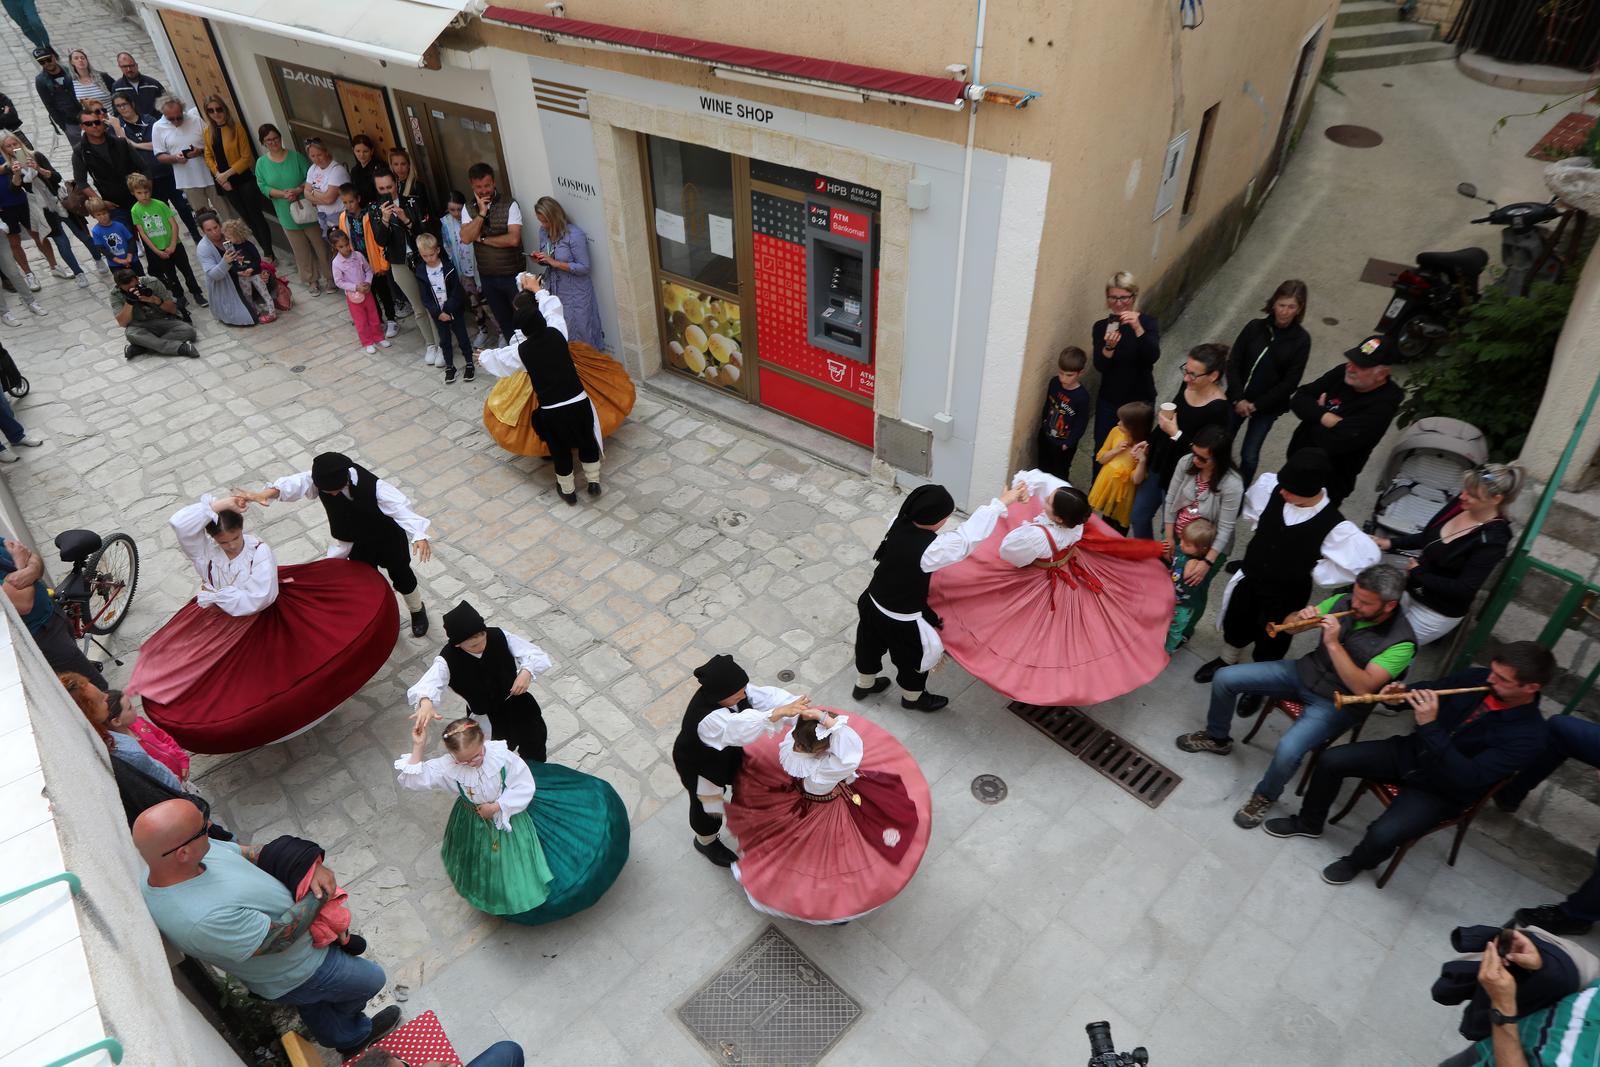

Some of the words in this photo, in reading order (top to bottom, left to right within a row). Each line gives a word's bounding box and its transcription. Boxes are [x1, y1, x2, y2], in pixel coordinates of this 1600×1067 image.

[281, 67, 335, 90] DAKINE
[700, 95, 733, 115] WINE
[736, 104, 774, 124] SHOP
[557, 176, 596, 196] GOSPOJA
[827, 183, 847, 196] HPB
[850, 187, 864, 196] ATM
[816, 208, 828, 216] HPB
[811, 216, 827, 226] 0-24
[833, 213, 849, 222] ATM
[832, 222, 865, 237] Bankomat
[860, 371, 875, 380] ATM
[860, 378, 874, 388] 0-24
